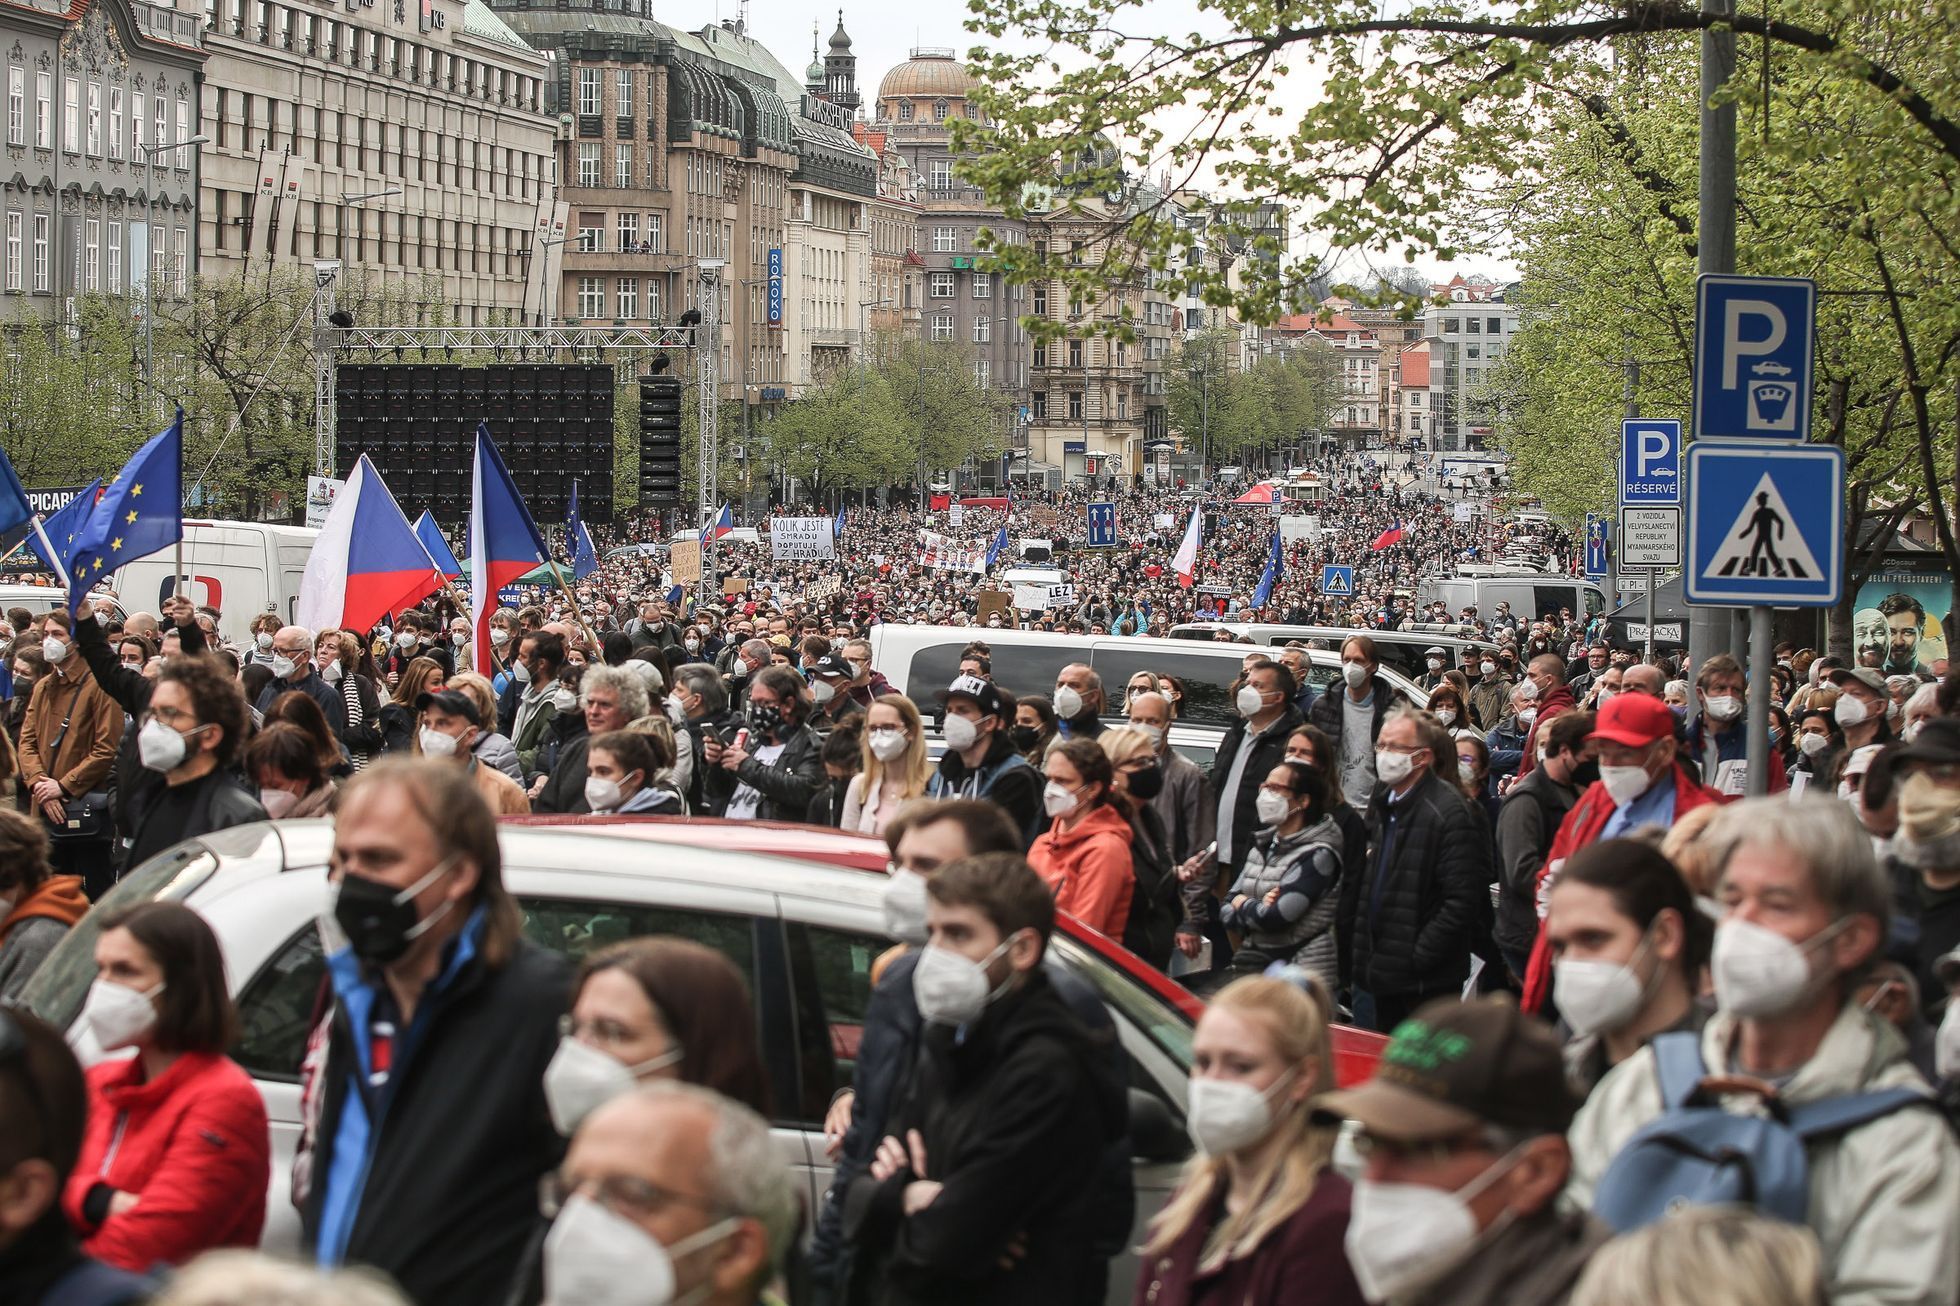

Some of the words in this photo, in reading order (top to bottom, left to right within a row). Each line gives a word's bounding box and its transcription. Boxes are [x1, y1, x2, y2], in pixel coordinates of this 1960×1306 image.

[433, 10, 446, 29] KB
[1722, 299, 1787, 390] P
[1637, 430, 1670, 477] P
[1626, 482, 1677, 494] RÉSERVÉ
[1636, 512, 1641, 520] 2
[1642, 512, 1666, 520] VOZIDLA
[773, 519, 799, 532] KOLIK
[1627, 521, 1676, 530] VELVYSLANECTVÍ
[780, 532, 818, 540] SMRADU
[1635, 532, 1667, 541] REPUBLIKY
[781, 549, 790, 557] Z
[793, 545, 831, 558] HRADU?
[1626, 543, 1676, 551] MYANMARSKÉHO
[1642, 553, 1661, 561] SVAZU
